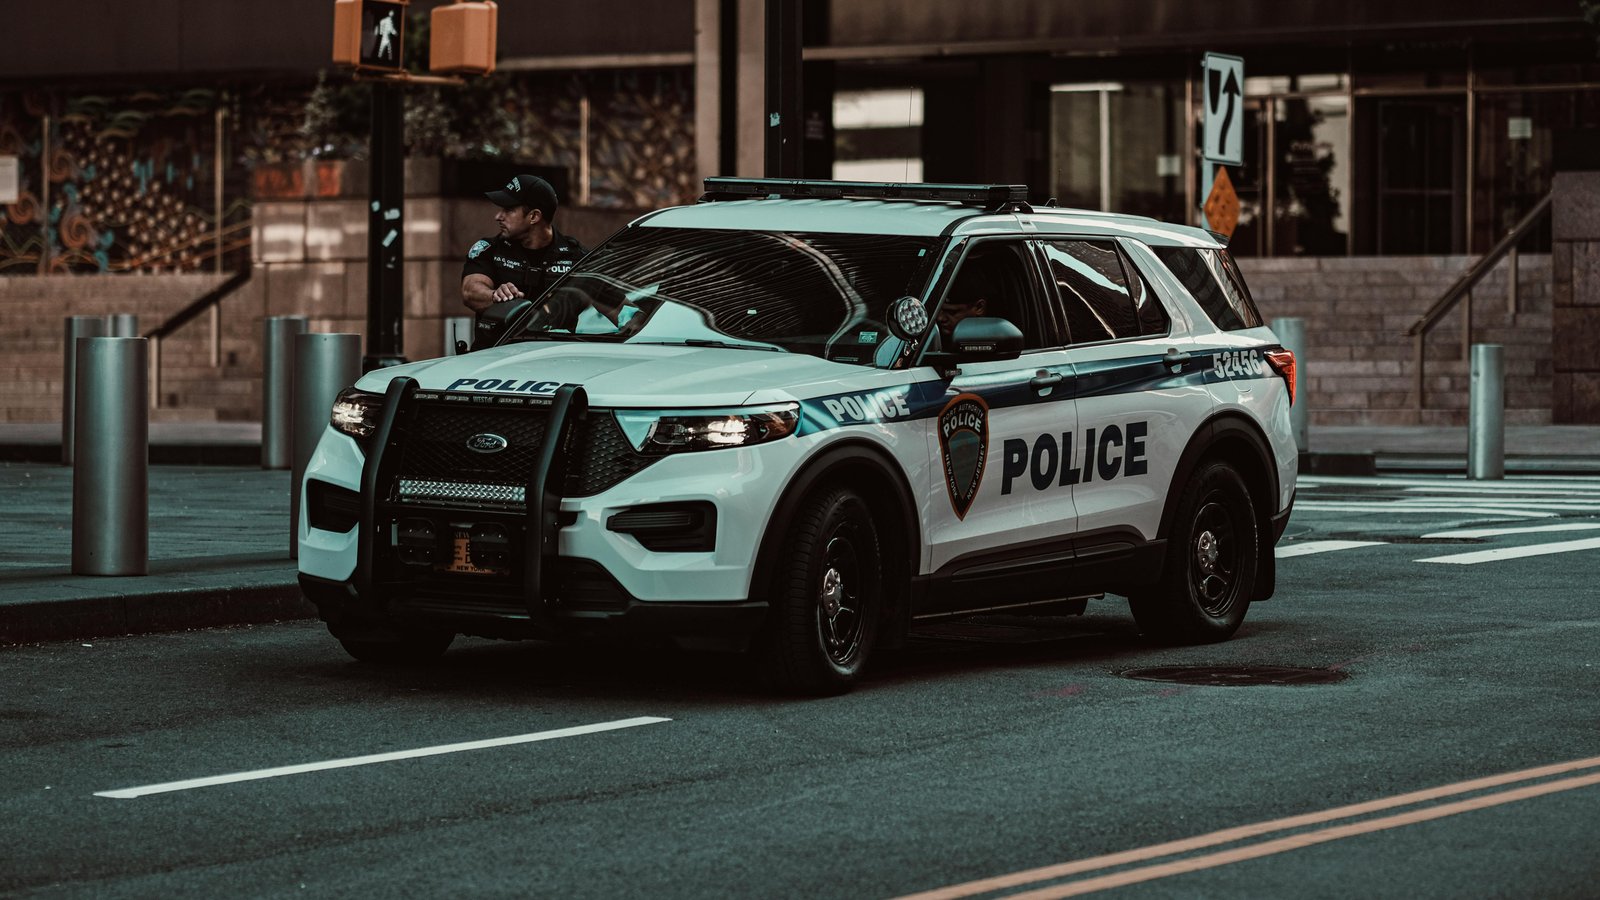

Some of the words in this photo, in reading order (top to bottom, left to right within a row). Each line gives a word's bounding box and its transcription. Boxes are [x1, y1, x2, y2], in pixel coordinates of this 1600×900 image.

[1213, 349, 1263, 379] 52456
[822, 390, 911, 423] POLICE
[942, 407, 957, 424] PORT
[958, 403, 984, 419] AUTHORITY
[943, 411, 982, 438] POLICE
[473, 437, 497, 449] Ford
[1001, 420, 1148, 496] POLICE
[967, 479, 977, 500] NEW
[975, 444, 985, 479] JERSEY
